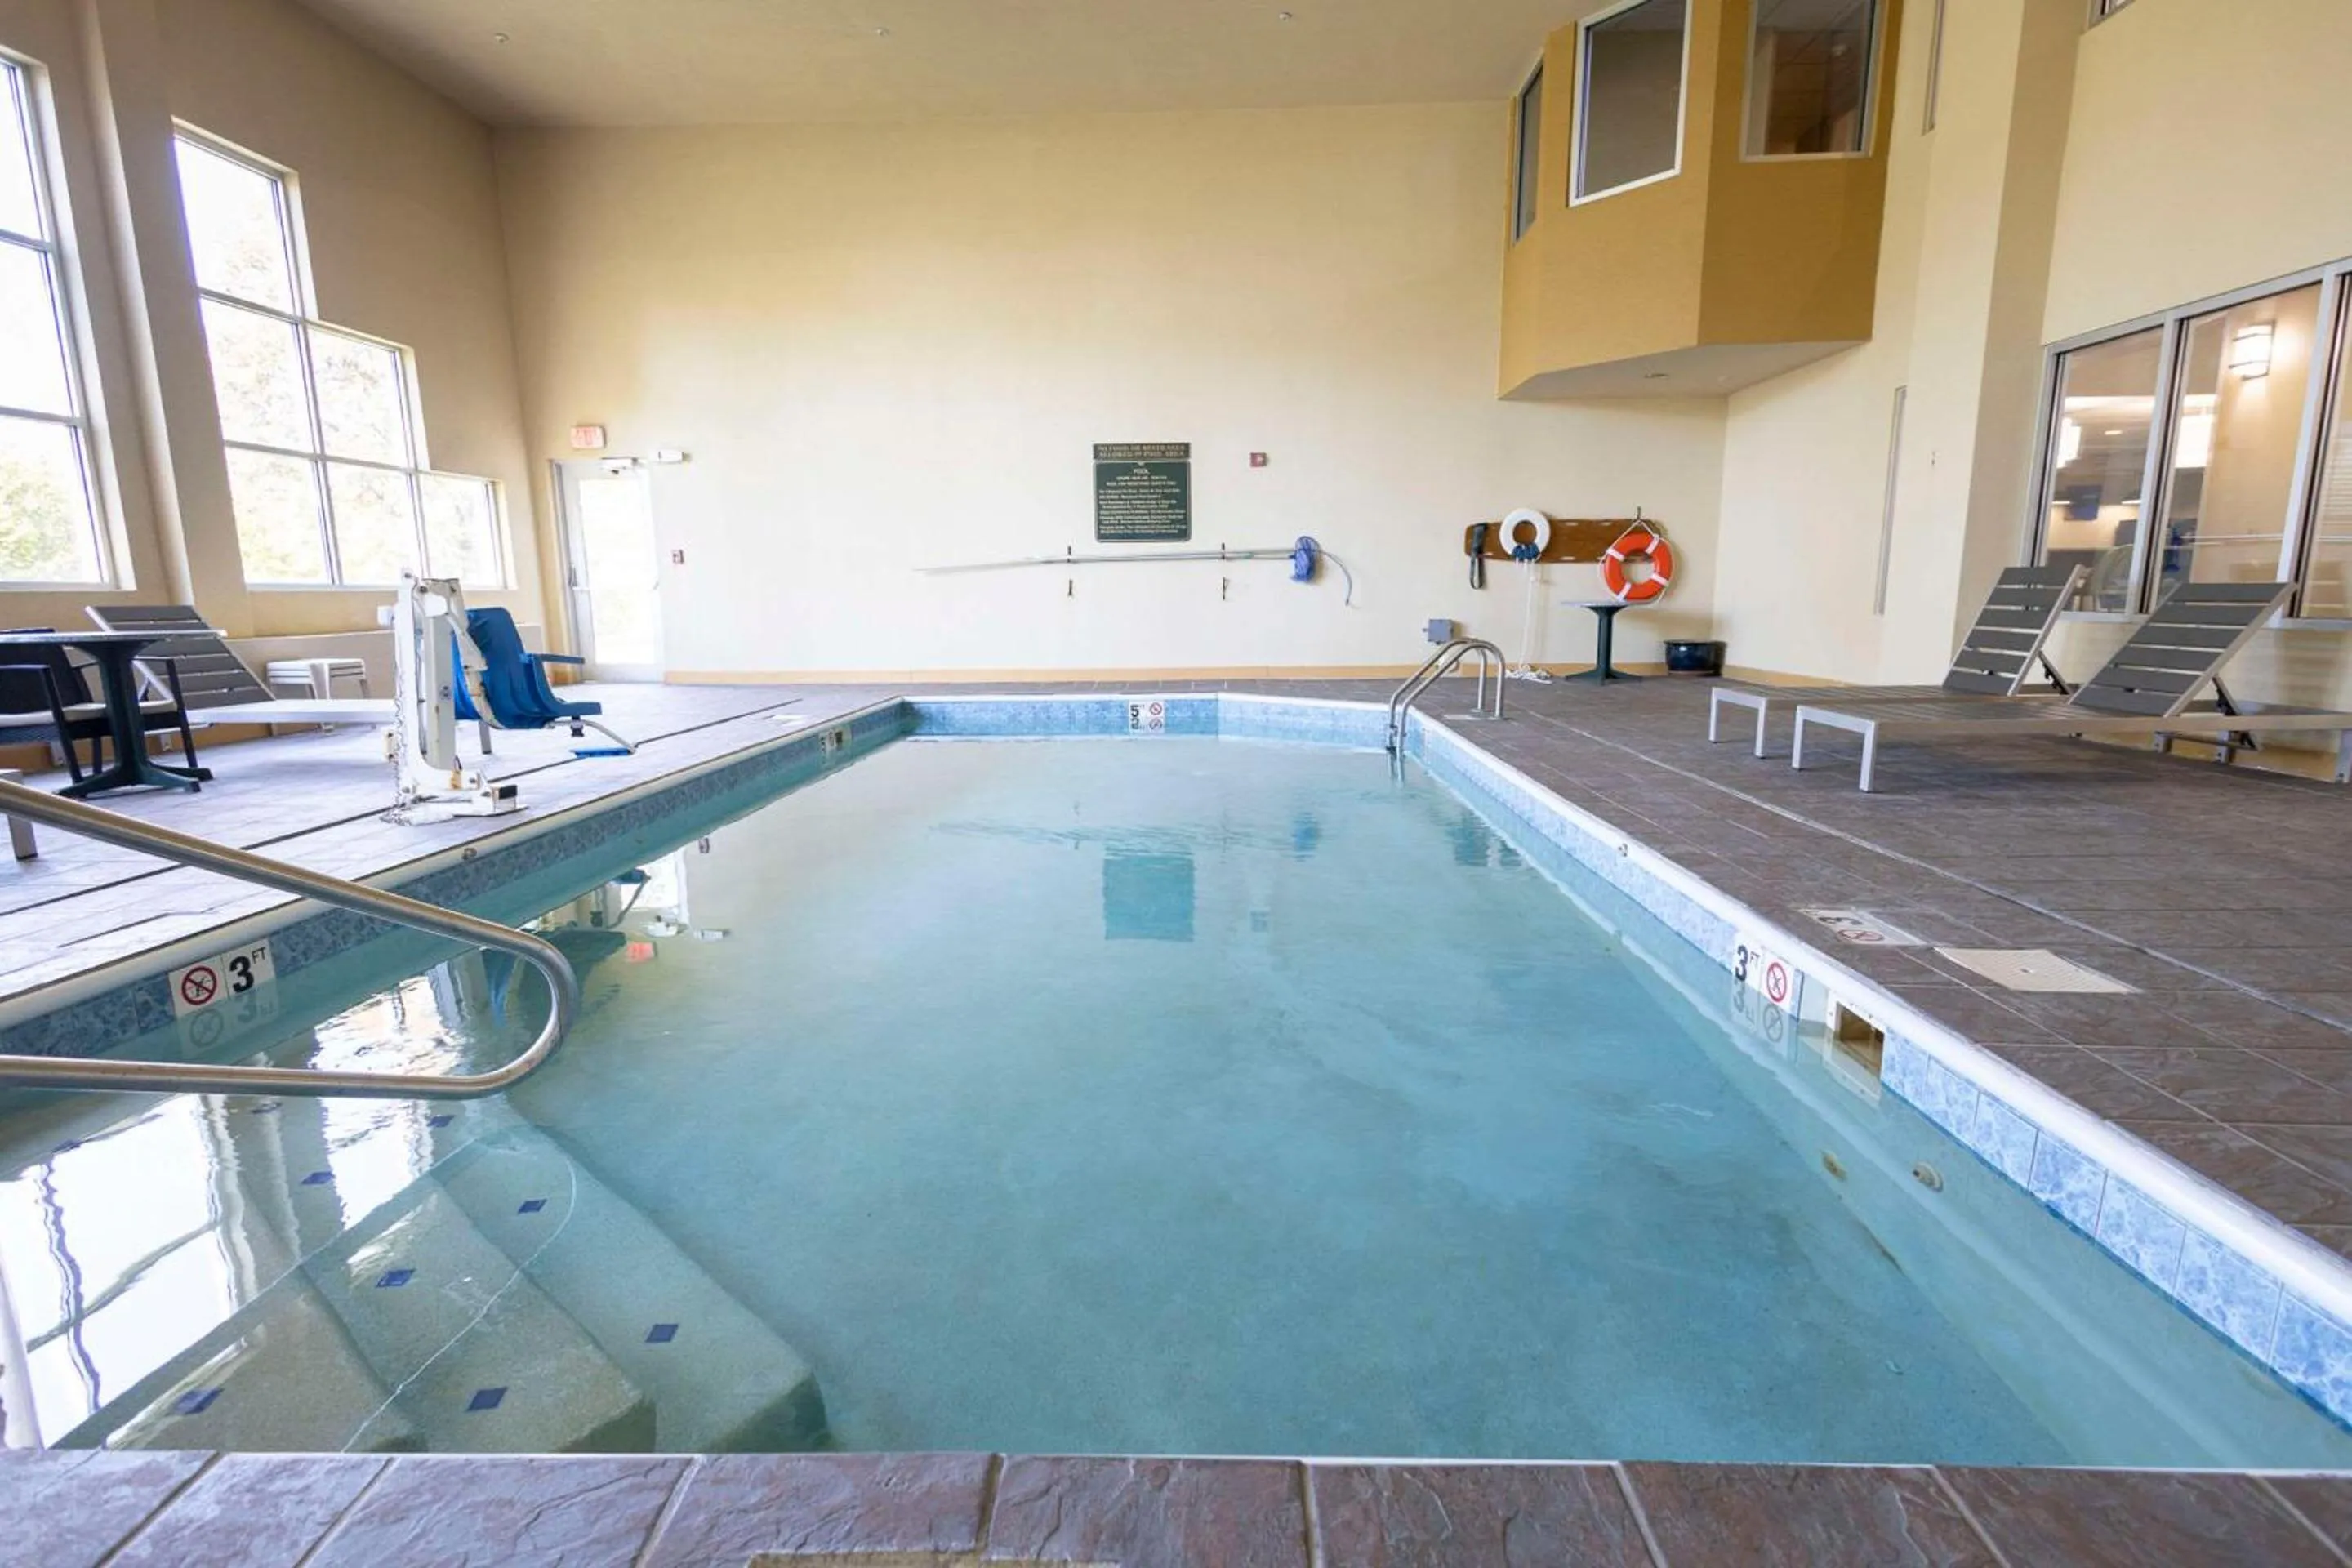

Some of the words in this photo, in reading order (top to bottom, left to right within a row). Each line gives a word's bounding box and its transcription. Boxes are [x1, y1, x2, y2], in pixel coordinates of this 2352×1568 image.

[1130, 705, 1139, 717] 5
[229, 956, 254, 993] 3
[252, 947, 266, 964] FT
[1735, 945, 1748, 981] 3
